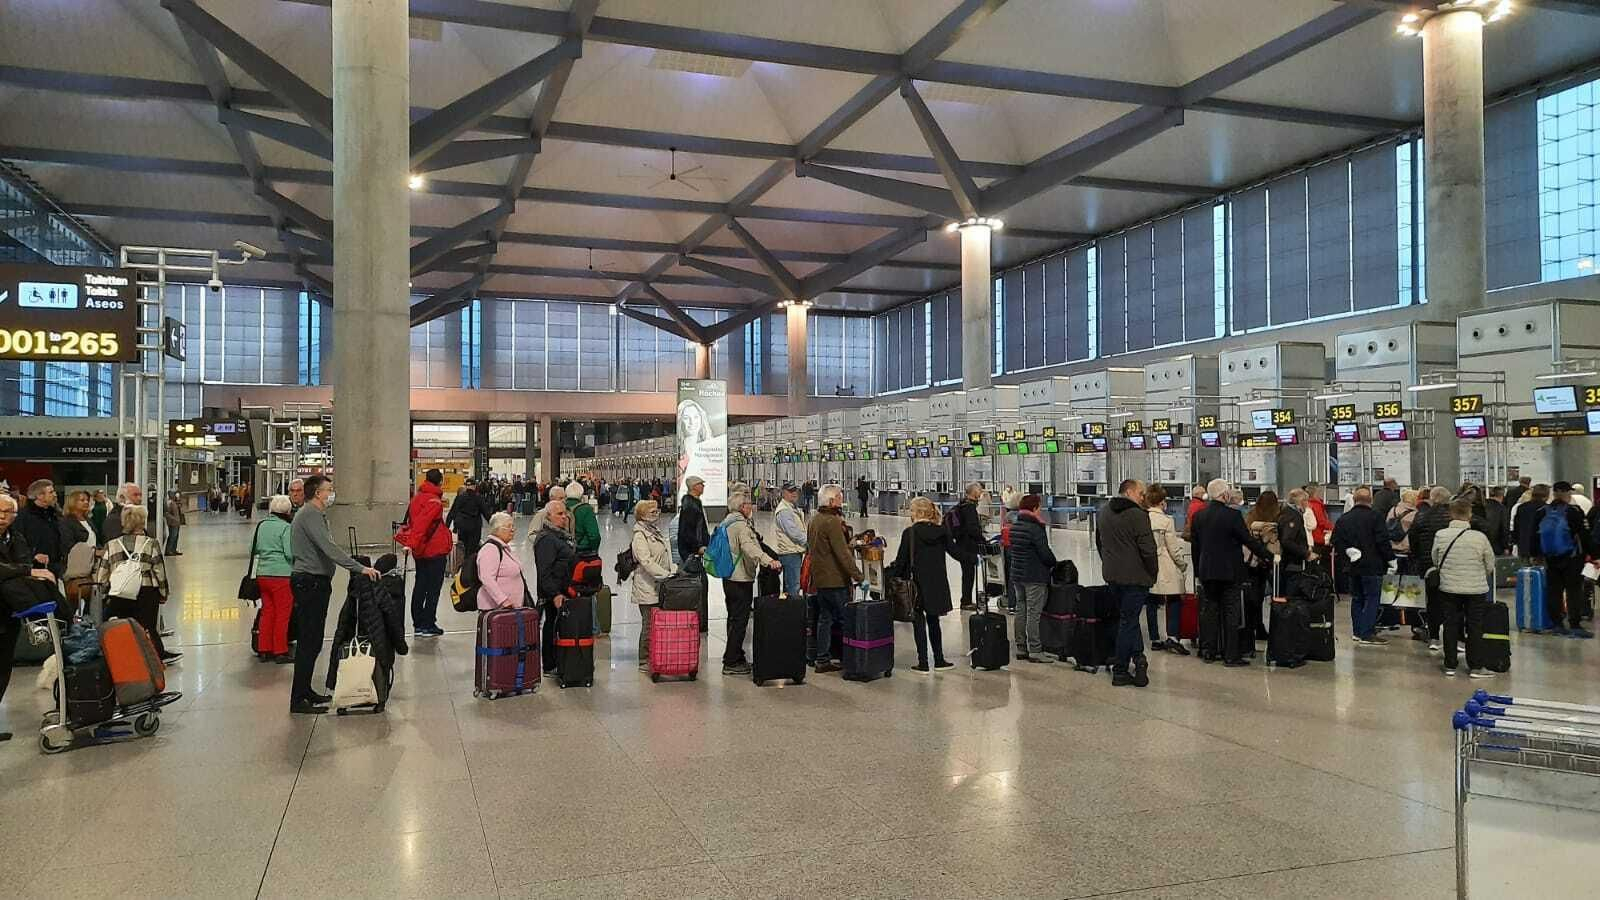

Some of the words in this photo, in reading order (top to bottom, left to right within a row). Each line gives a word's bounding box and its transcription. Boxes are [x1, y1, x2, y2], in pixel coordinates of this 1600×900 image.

[85, 285, 119, 297] Toilets
[85, 297, 124, 310] Aseos
[1376, 403, 1399, 416] 356
[1453, 397, 1478, 412] 357
[1273, 411, 1291, 423] 354
[1332, 406, 1352, 419] 355
[1127, 422, 1140, 432] 351
[1154, 420, 1168, 431] 352
[1199, 416, 1215, 428] 353
